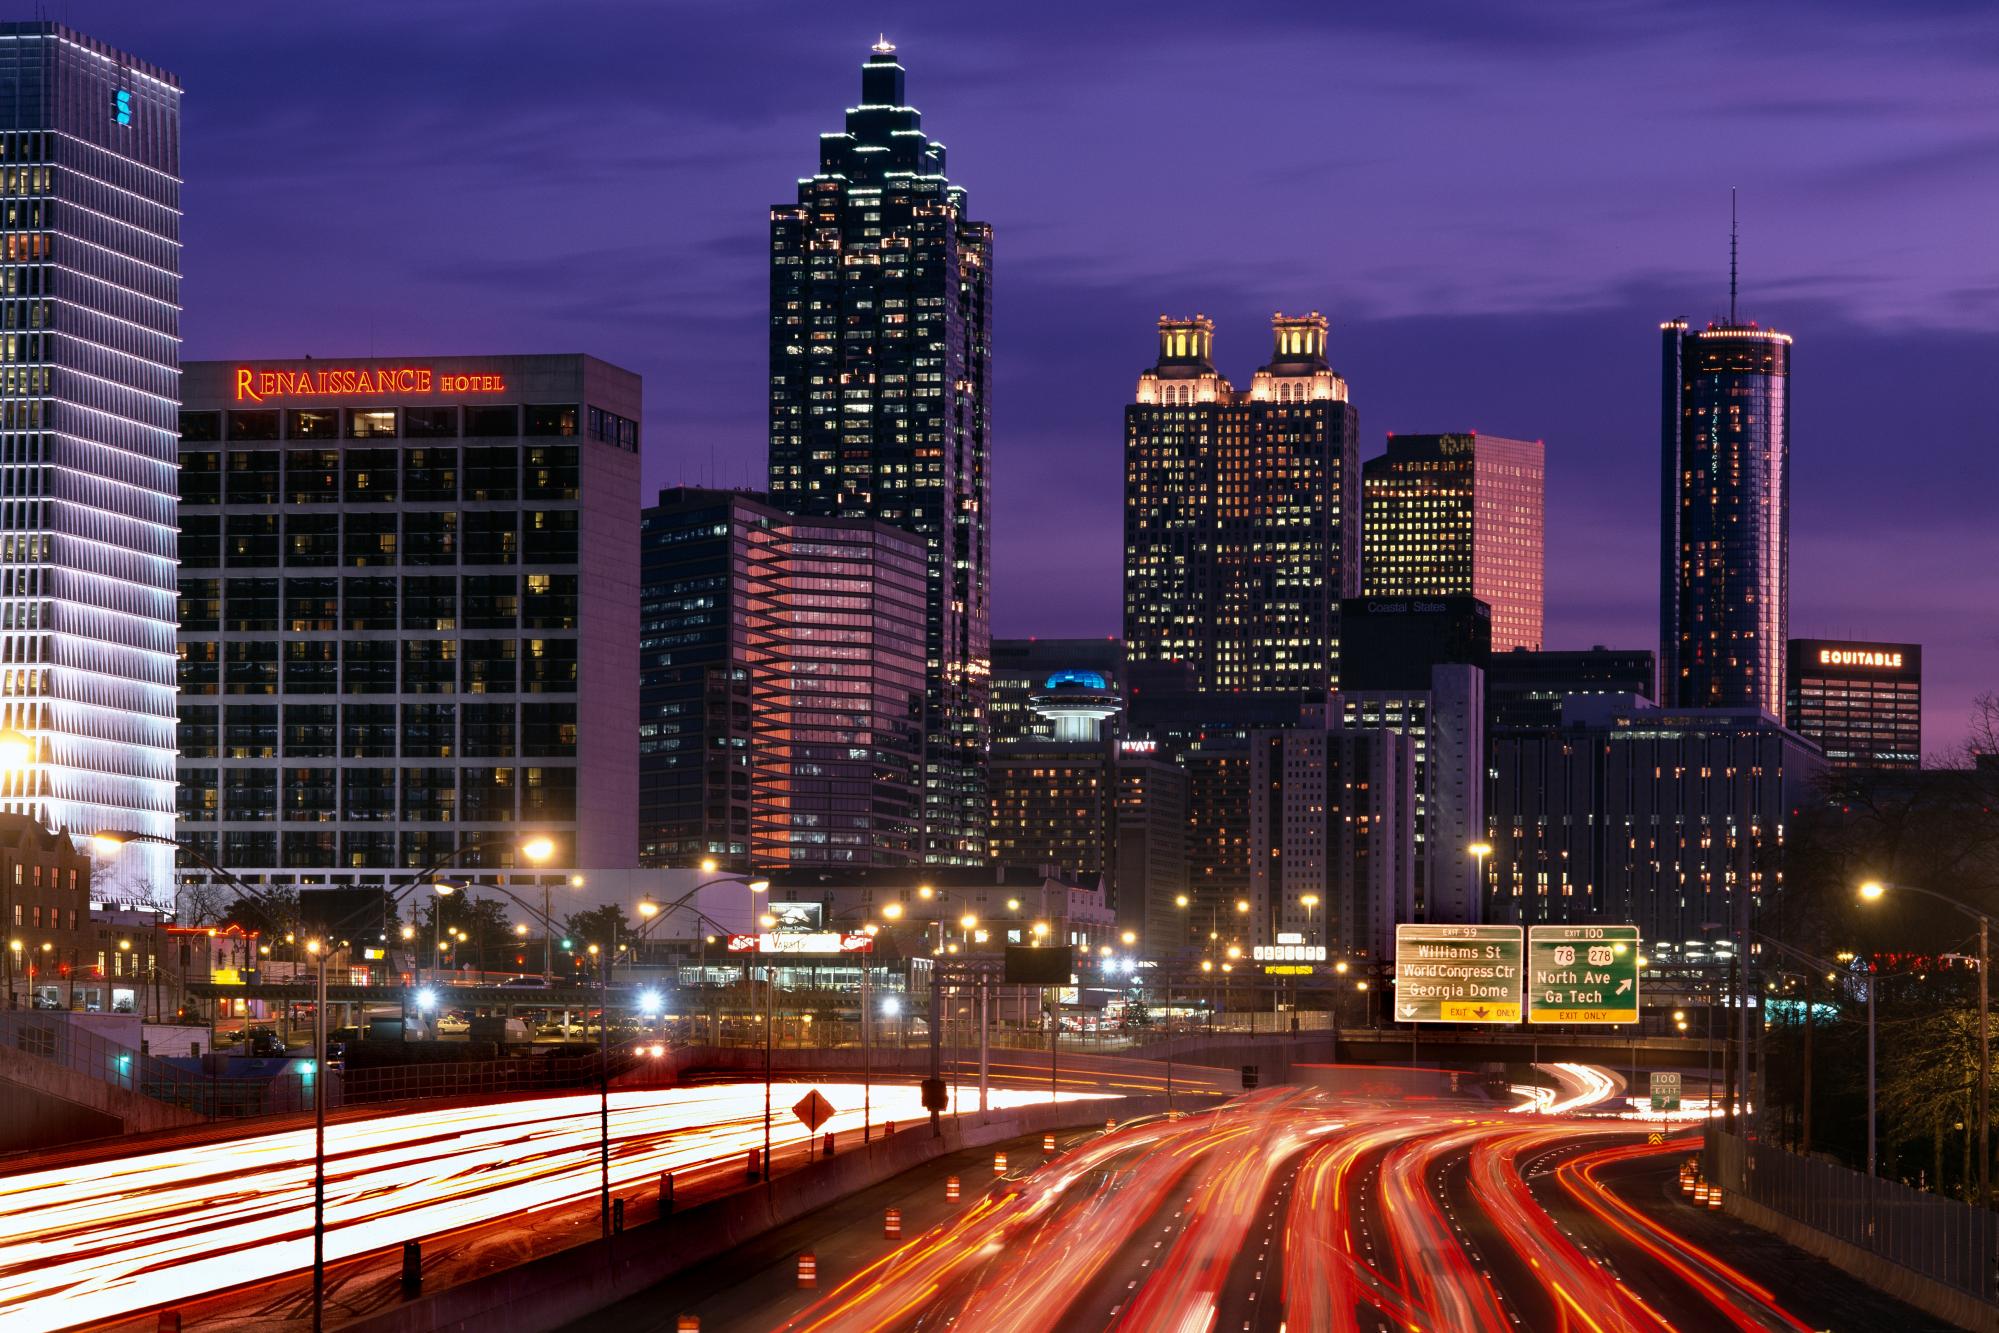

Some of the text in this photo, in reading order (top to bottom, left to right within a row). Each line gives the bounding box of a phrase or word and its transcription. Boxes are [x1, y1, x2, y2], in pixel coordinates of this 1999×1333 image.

[236, 368, 505, 401] RENAISSANCE HOTEL
[1367, 602, 1447, 613] Coastal States
[1820, 650, 1902, 667] EQUITABLE
[1121, 741, 1156, 752] HYATT
[1463, 928, 1477, 937] 99
[1585, 929, 1604, 938] 100
[1418, 945, 1501, 959] Williams St
[1557, 950, 1611, 961] 78 278
[1403, 964, 1515, 981] World Congress Ctr
[1537, 971, 1611, 984] North Ave
[1410, 983, 1508, 1000] Georgia Dome
[1545, 990, 1602, 1003] Ga Tech
[1450, 1008, 1516, 1017] EXIT ONLY
[1559, 1012, 1607, 1020] EXIT ONLY
[1656, 1074, 1676, 1084] 100
